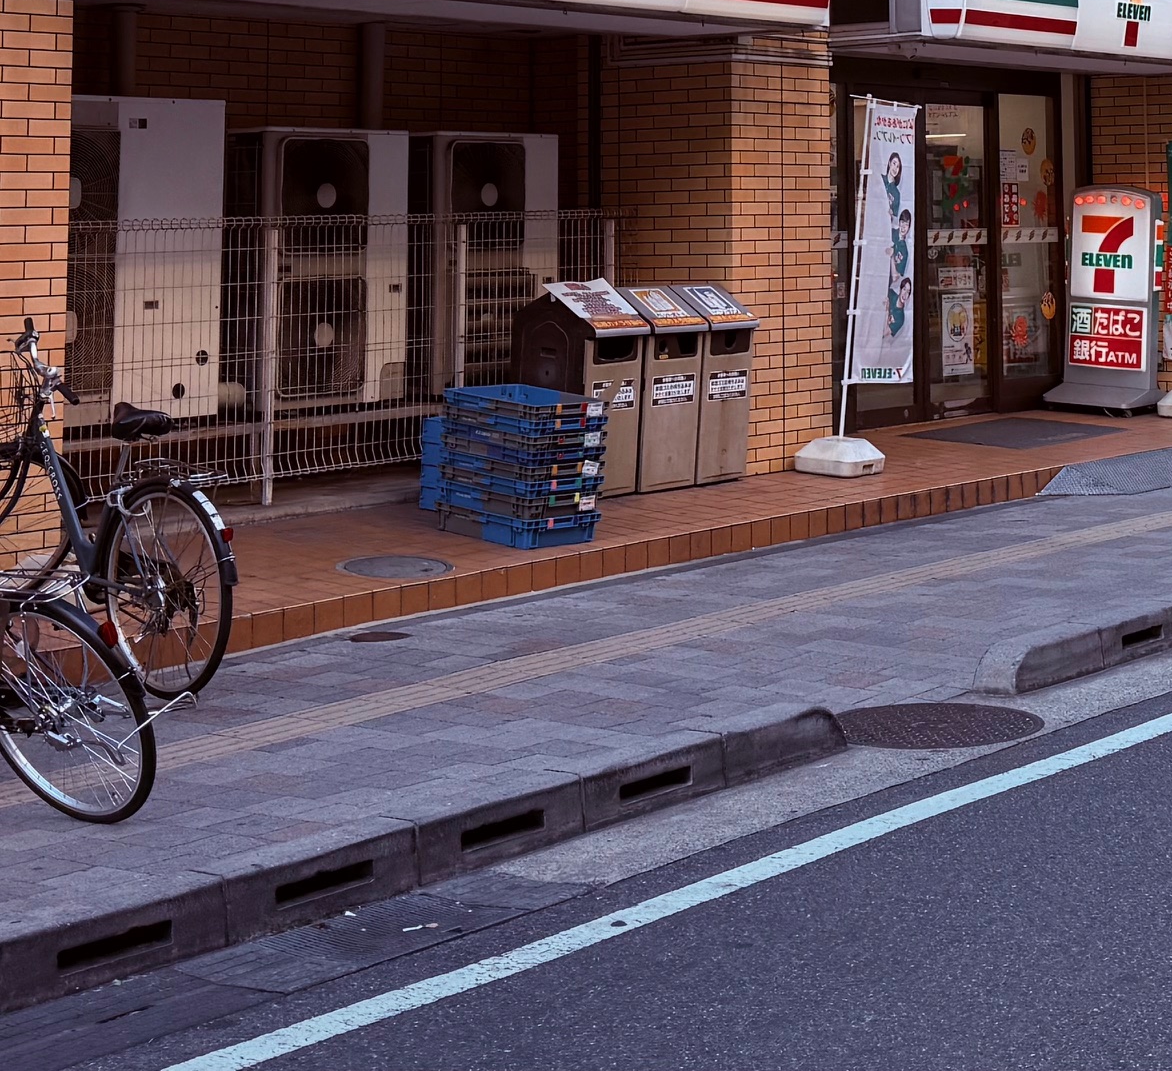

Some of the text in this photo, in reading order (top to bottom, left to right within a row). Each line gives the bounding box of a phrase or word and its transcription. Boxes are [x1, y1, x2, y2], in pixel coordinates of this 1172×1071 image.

[1082, 215, 1134, 294] 7
[1071, 307, 1092, 333] 酒
[1094, 309, 1141, 337] たばこ
[1073, 338, 1137, 365] 銀行ATM
